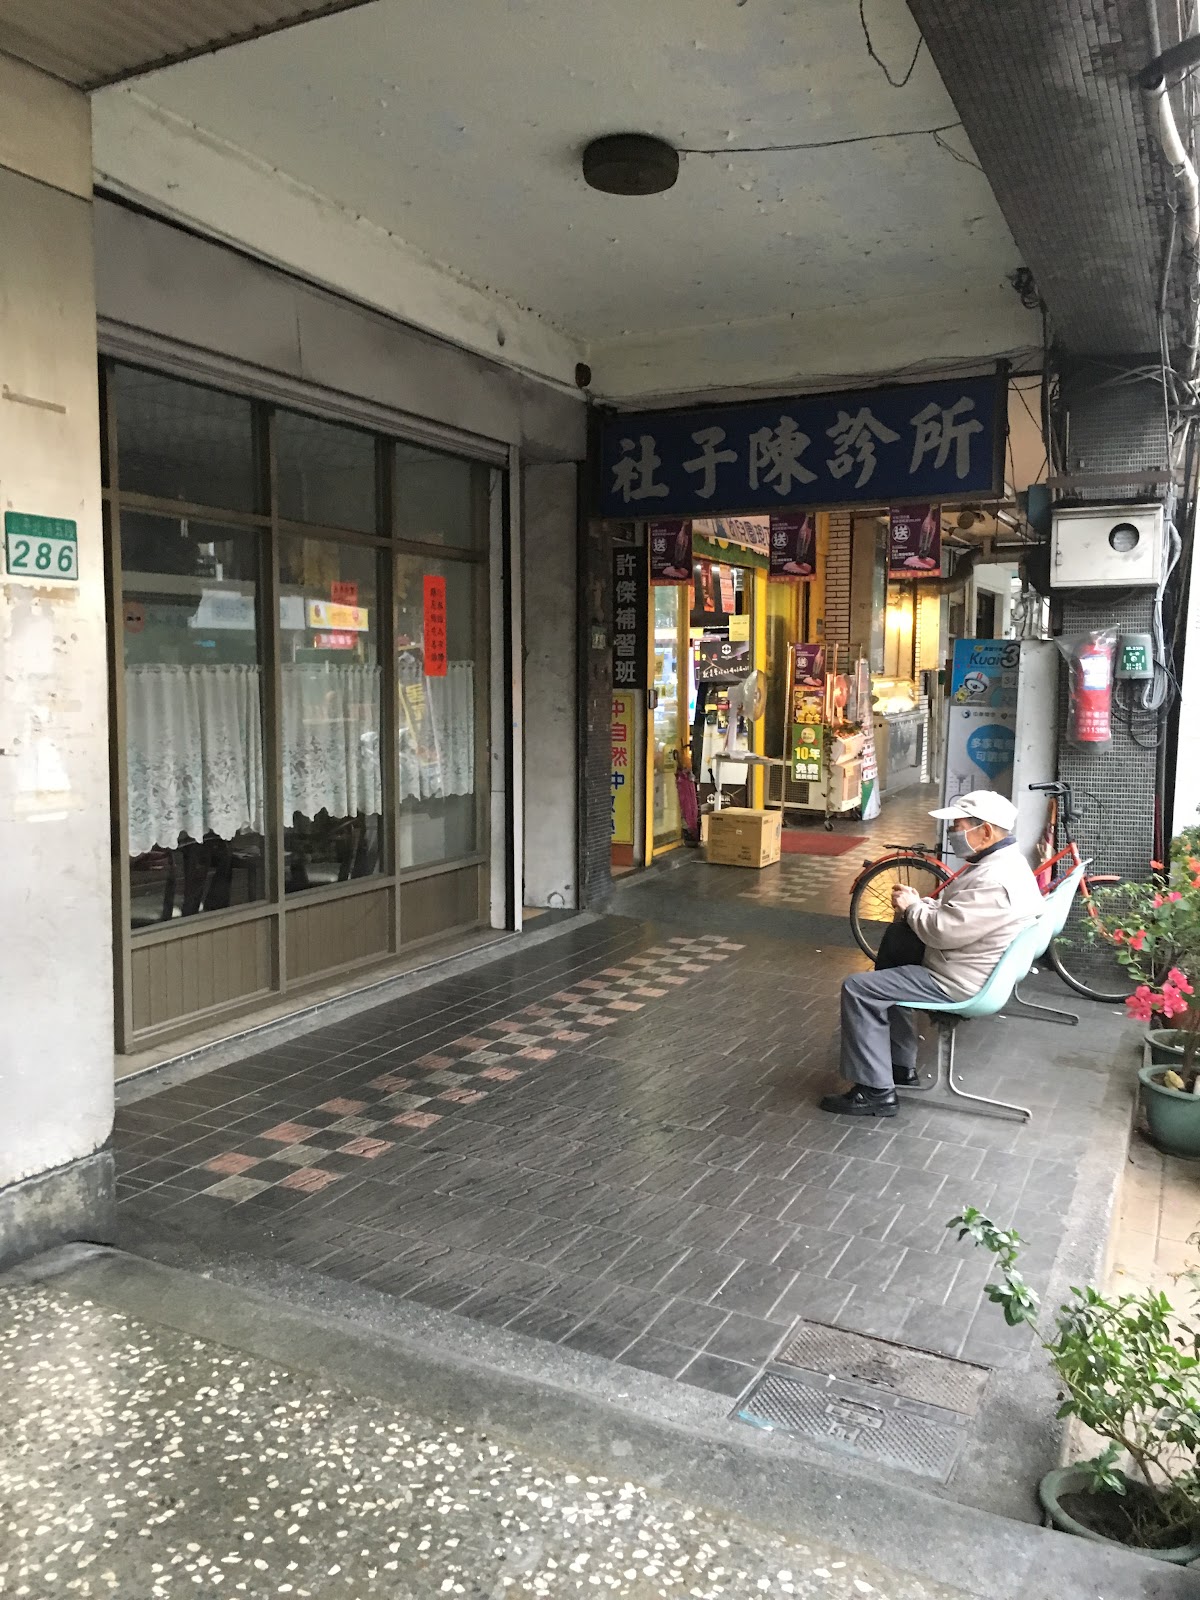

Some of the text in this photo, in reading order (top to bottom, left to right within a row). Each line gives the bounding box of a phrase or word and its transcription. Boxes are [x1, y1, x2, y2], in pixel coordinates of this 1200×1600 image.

[610, 396, 985, 503] 社子陳診所
[773, 532, 788, 548] 送
[892, 524, 909, 541] 送
[653, 537, 668, 554] 送
[12, 540, 74, 572] 286
[615, 553, 637, 683] 許傑補習班
[794, 746, 821, 761] 10年
[795, 762, 819, 774] 免費
